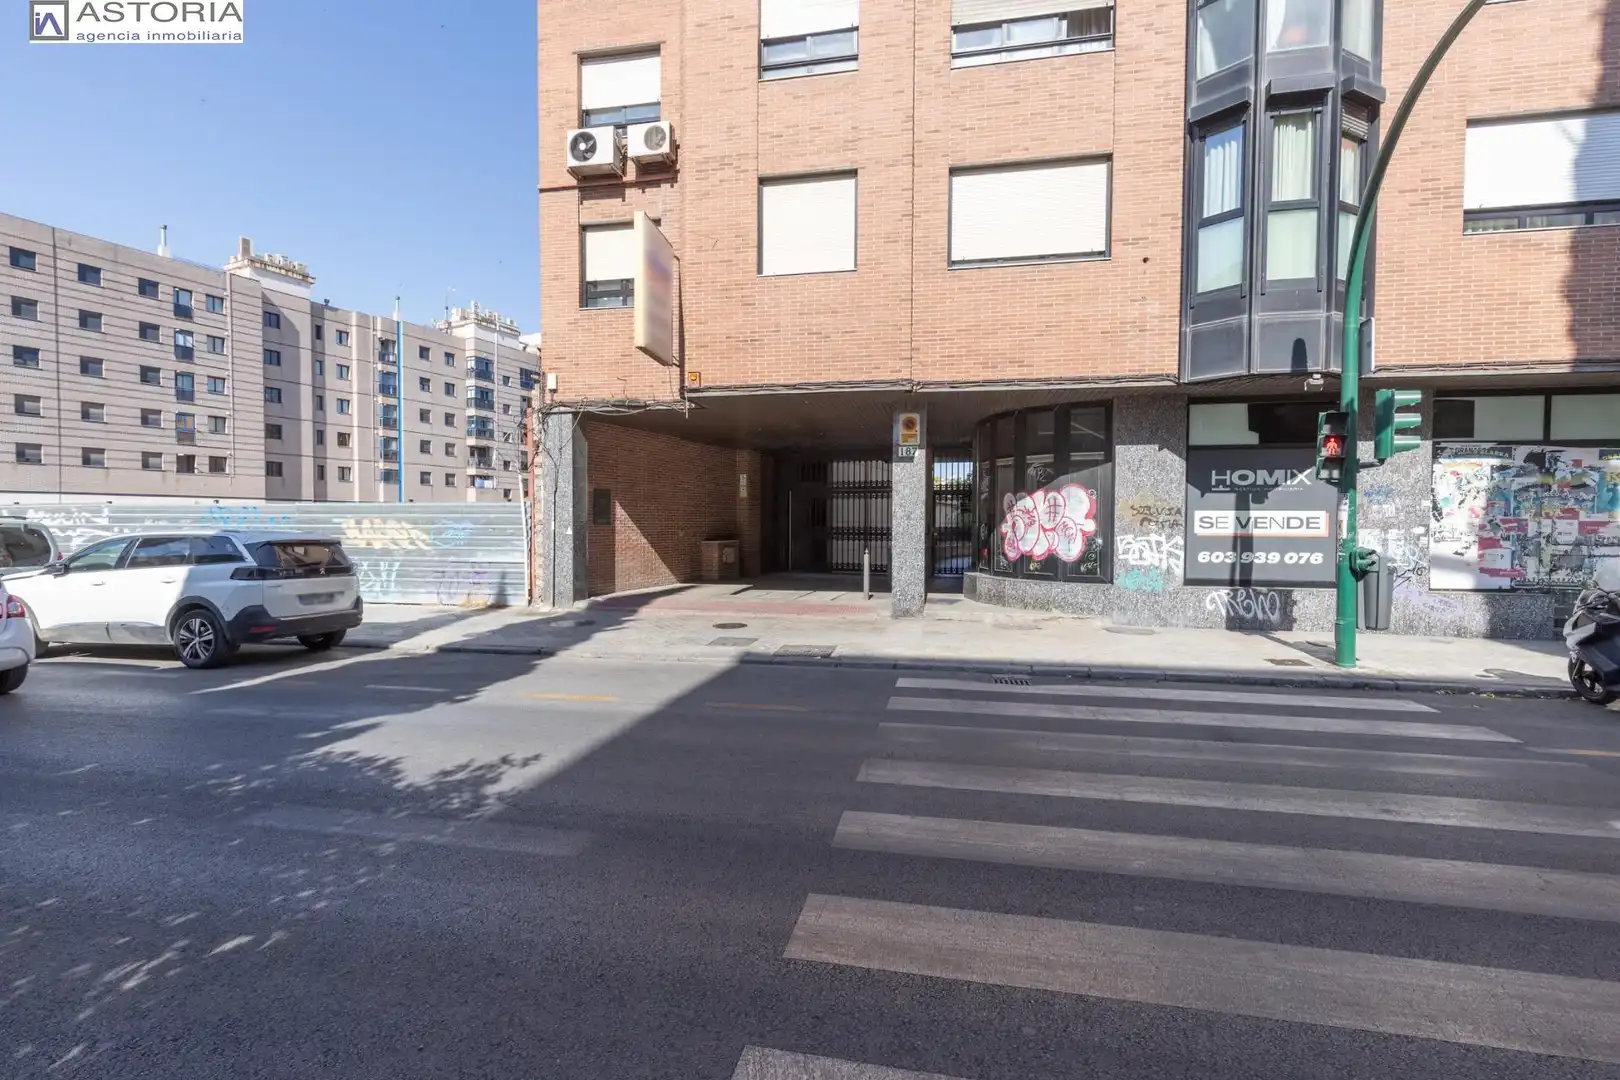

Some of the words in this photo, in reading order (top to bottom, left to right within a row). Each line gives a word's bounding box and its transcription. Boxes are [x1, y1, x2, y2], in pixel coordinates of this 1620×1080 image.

[1211, 468, 1313, 486] HOMIX
[1199, 516, 1229, 530] SE
[1236, 516, 1321, 530] VENDE
[1197, 551, 1237, 564] 603
[1240, 551, 1280, 564] 939
[1283, 551, 1324, 565] 076
